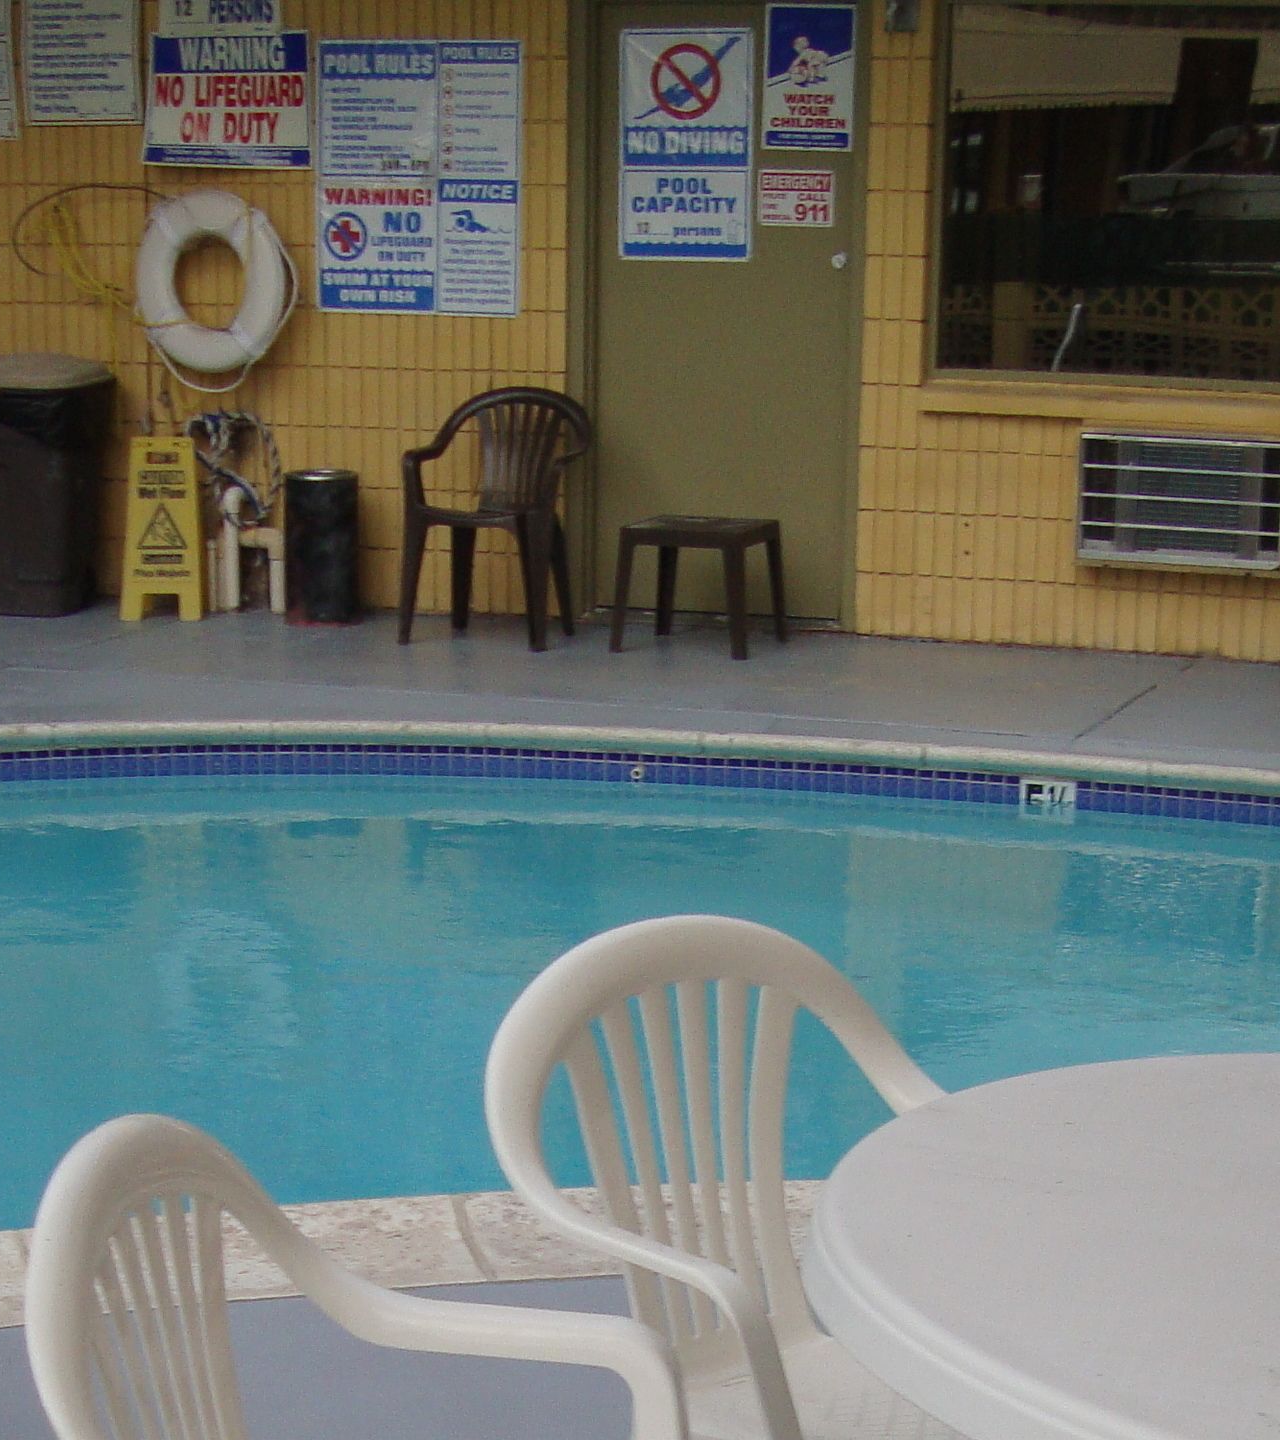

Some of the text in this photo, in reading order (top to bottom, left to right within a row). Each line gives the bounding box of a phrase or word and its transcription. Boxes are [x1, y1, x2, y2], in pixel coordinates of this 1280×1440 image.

[209, 0, 273, 23] PERSONS
[178, 36, 286, 71] WARNING
[442, 46, 517, 60] POOL RULES
[324, 54, 434, 75] POOL RULES
[155, 76, 184, 107] NO
[195, 75, 304, 107] LIFEGUARD
[785, 94, 835, 105] WATCH
[789, 106, 830, 117] YOUR
[180, 112, 279, 143] ON DUTY
[770, 117, 846, 129] CHILDREN
[627, 131, 744, 154] NO DIVING
[442, 184, 514, 200] NOTICE
[656, 178, 712, 195] POOL
[324, 188, 432, 206] WARNING!
[631, 196, 737, 214] CAPACITY
[797, 193, 827, 202] CALL
[795, 203, 829, 222] 911
[384, 211, 420, 233] NO
[371, 236, 433, 248] LIFEGUARD
[323, 272, 434, 287] SWIM AT YOUR
[340, 289, 416, 303] OWN RISK
